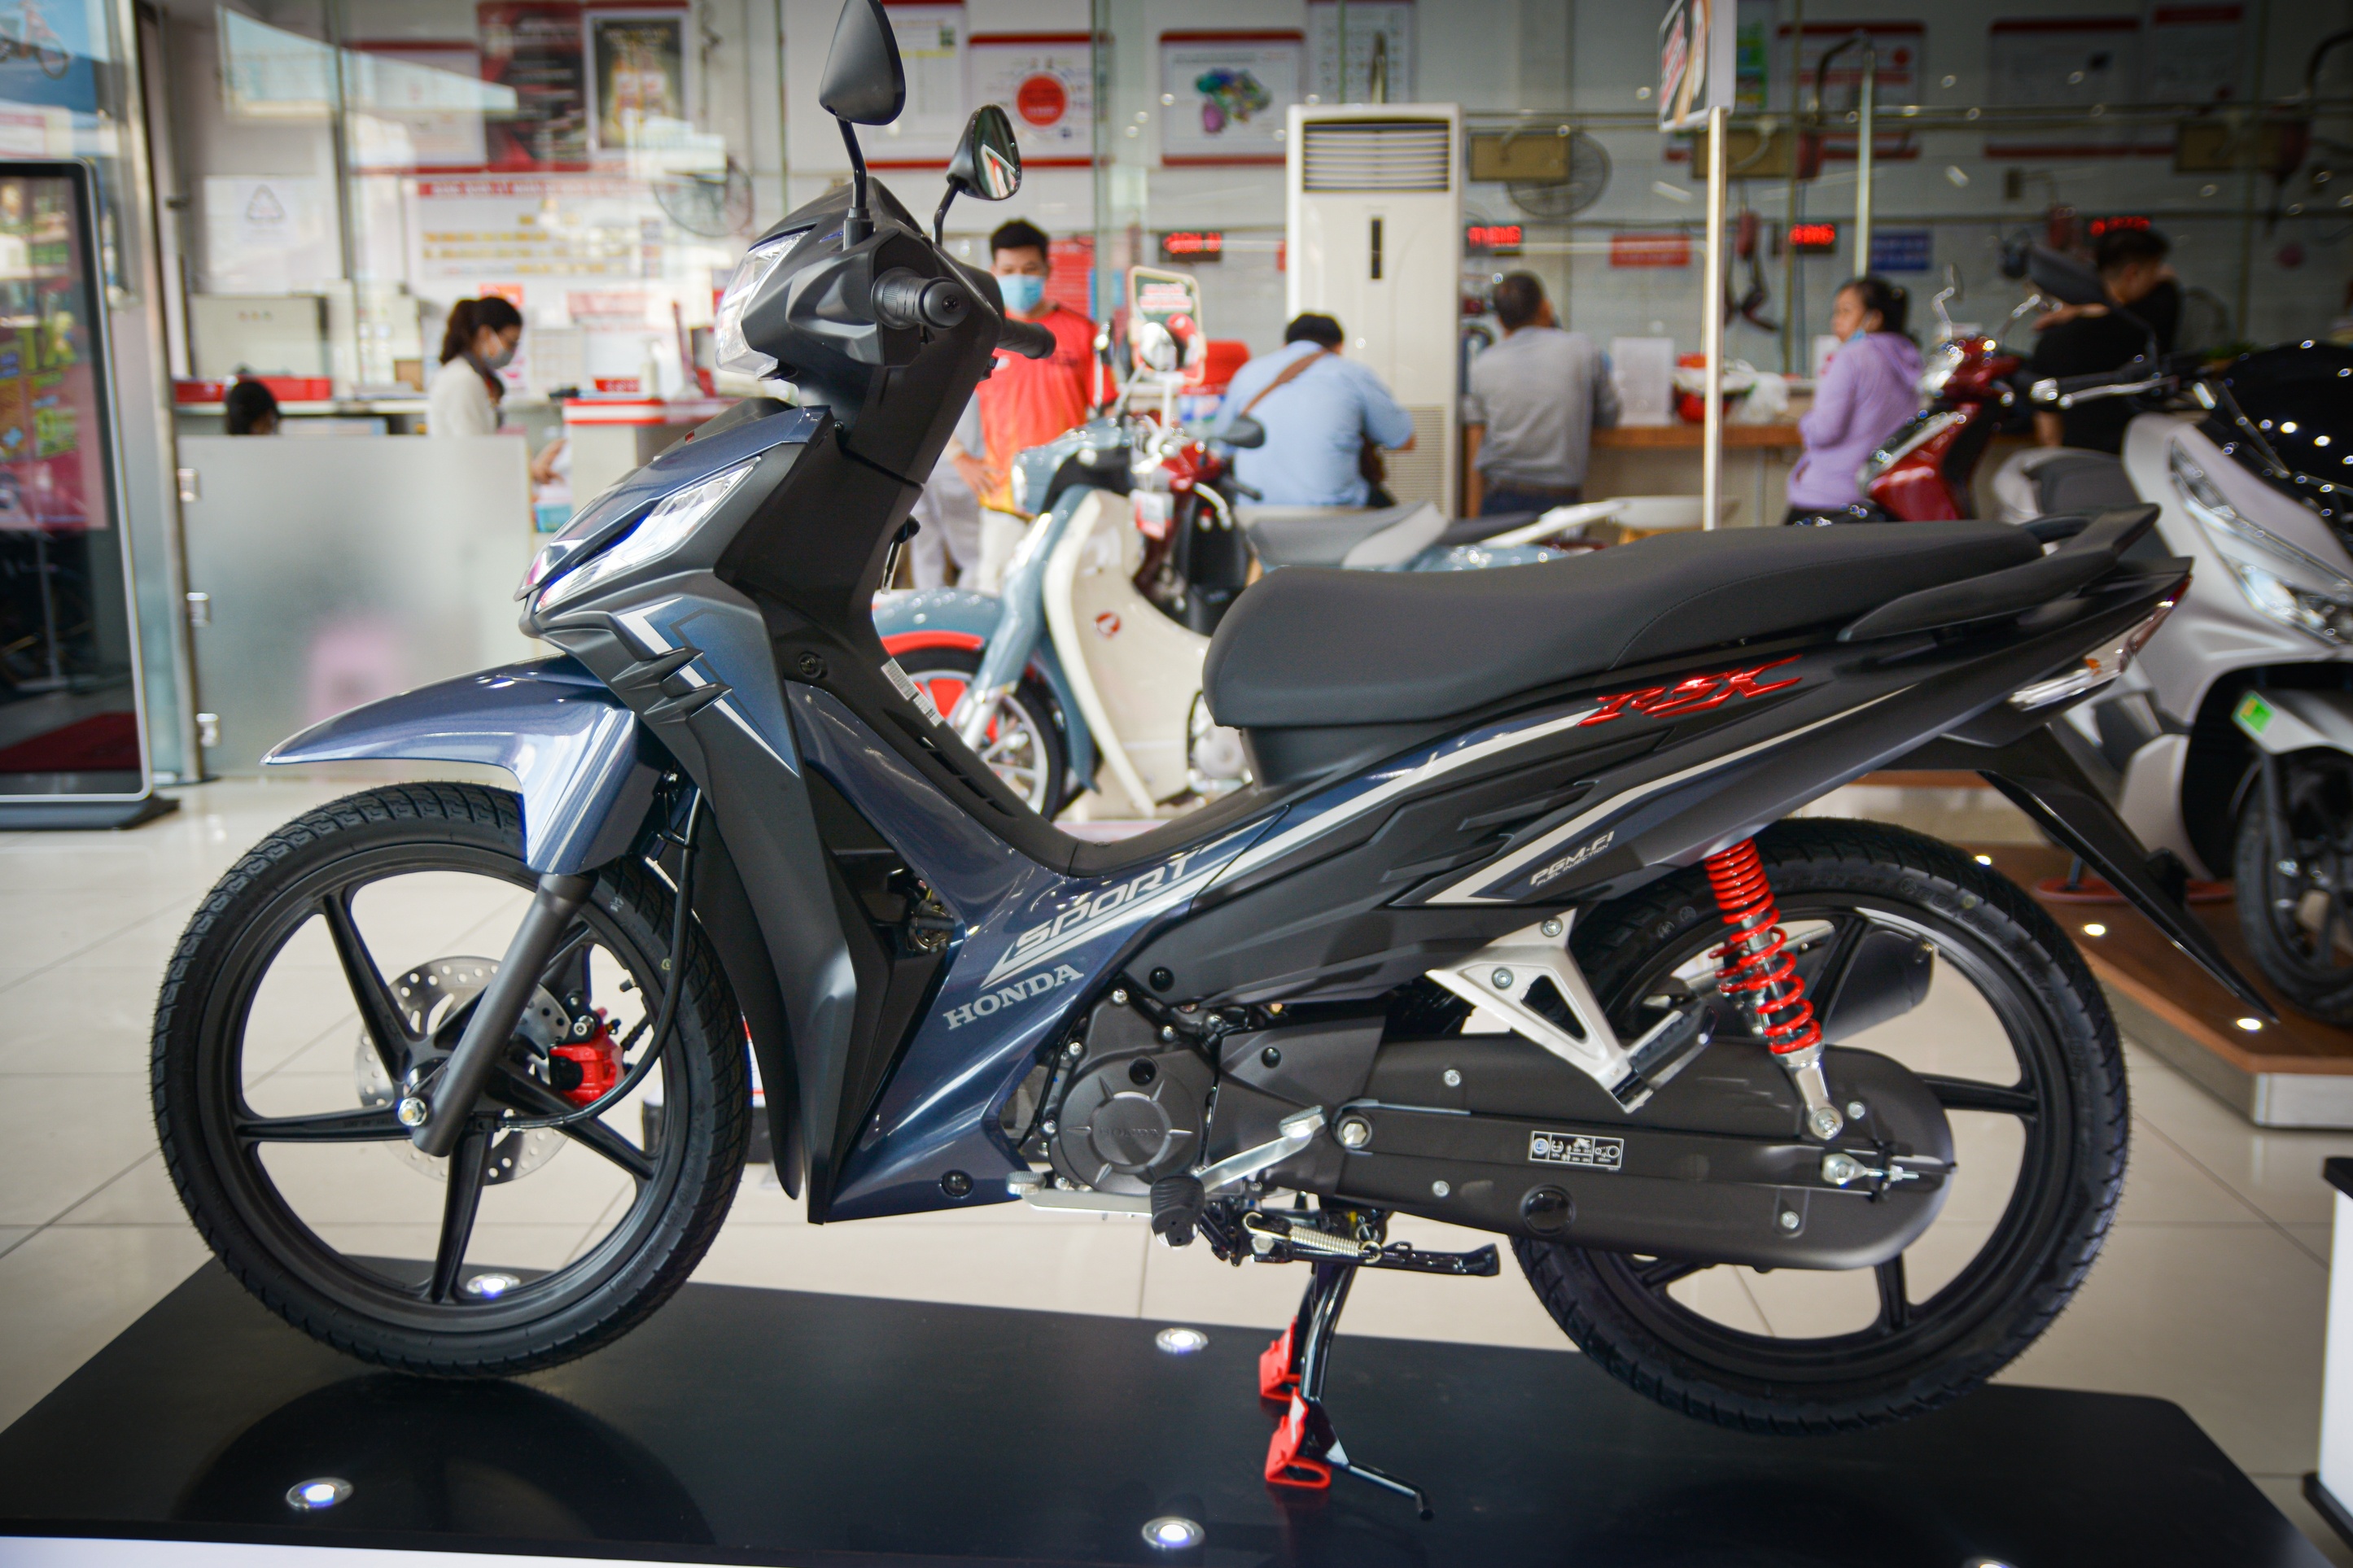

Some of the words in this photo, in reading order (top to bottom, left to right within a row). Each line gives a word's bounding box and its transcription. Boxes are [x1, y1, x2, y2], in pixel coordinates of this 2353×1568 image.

[1577, 654, 1804, 727] RSX
[1530, 831, 1615, 885] PGM-FI
[1536, 871, 1561, 887] FUEL
[1563, 843, 1609, 871] INJECTION
[1014, 850, 1197, 957] SPORT
[943, 963, 1084, 1030] HONDA
